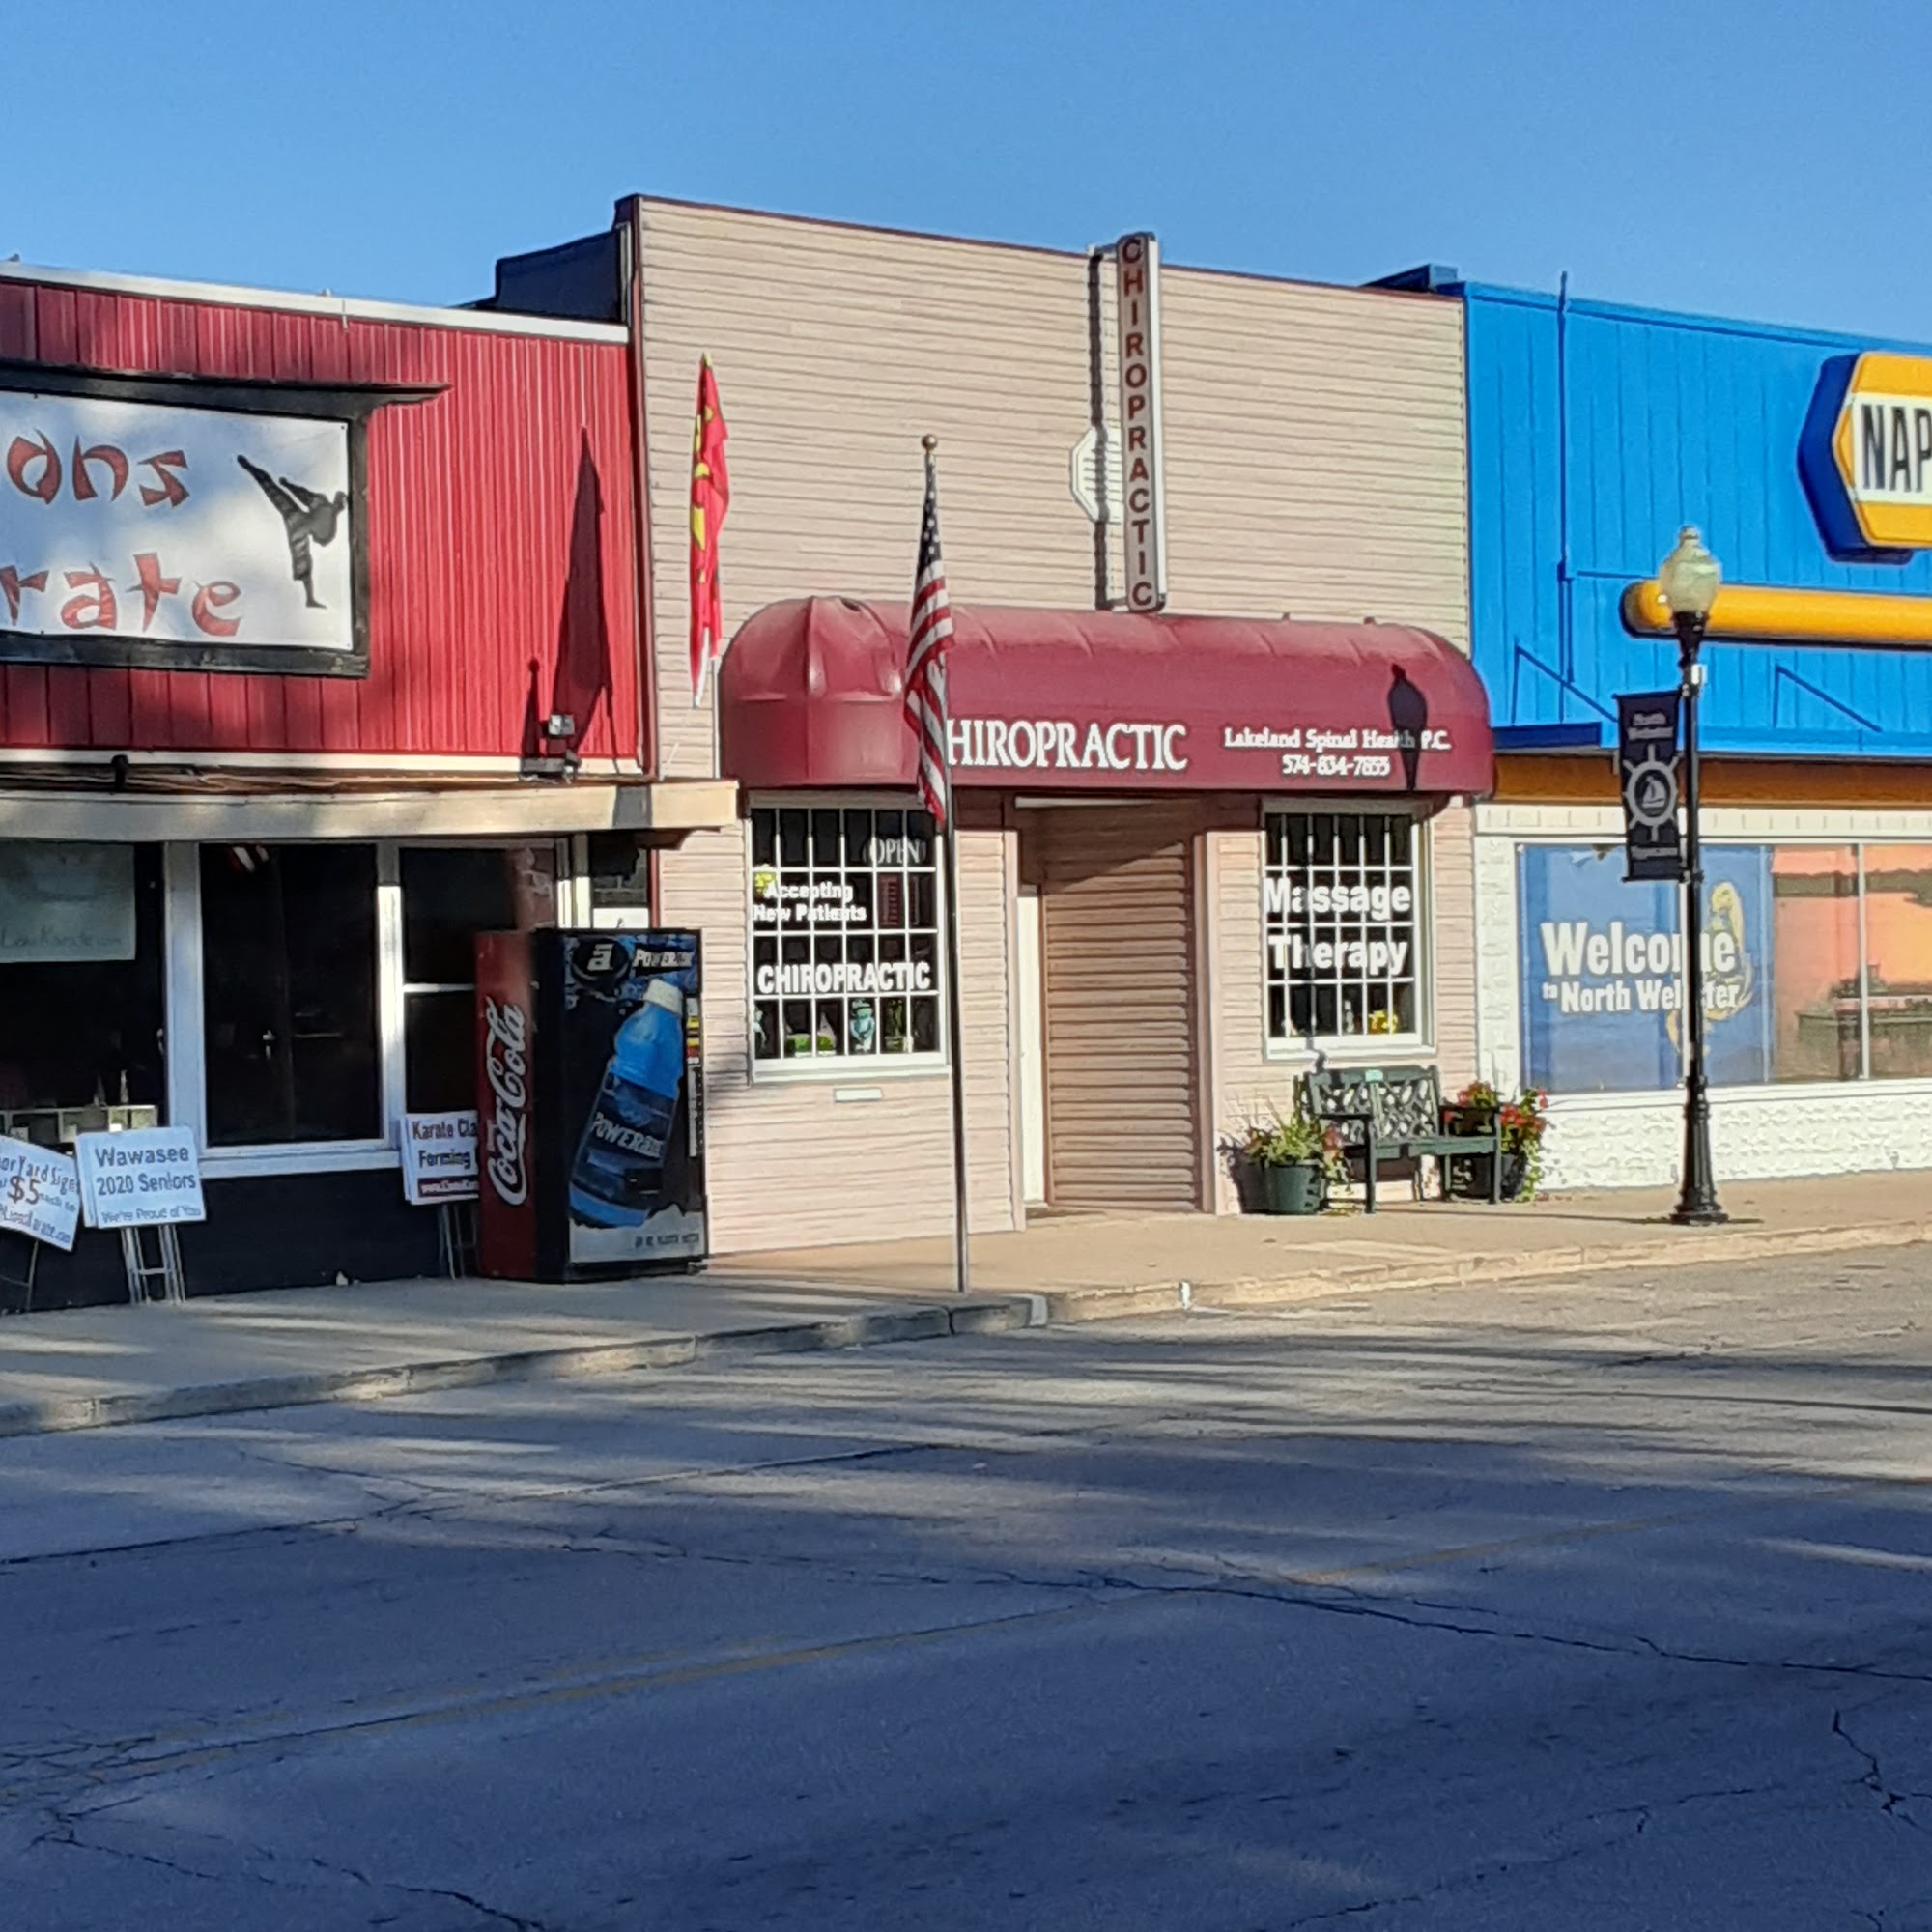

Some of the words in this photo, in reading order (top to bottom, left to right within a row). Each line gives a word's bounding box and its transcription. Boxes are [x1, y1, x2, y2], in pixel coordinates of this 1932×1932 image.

[1122, 238, 1153, 608] CHIROPRACTIC
[947, 718, 1189, 770] HIROPRACTIC
[1224, 726, 1301, 749] Lakeland
[1305, 728, 1358, 753] Spinal
[1361, 729, 1416, 750] Health
[869, 838, 922, 865] OPEN
[763, 880, 854, 904] Accepting
[1264, 878, 1410, 921] Massage
[752, 903, 791, 922] New
[795, 903, 867, 922] Patients
[1267, 934, 1407, 976] Therapy
[757, 961, 931, 995] CHIROPRACTIC
[1560, 980, 1632, 1013] North
[1634, 979, 1740, 1011] Weter
[95, 1147, 190, 1168] Wawasee
[97, 1174, 134, 1196] 2020
[137, 1171, 197, 1192] Seniors
